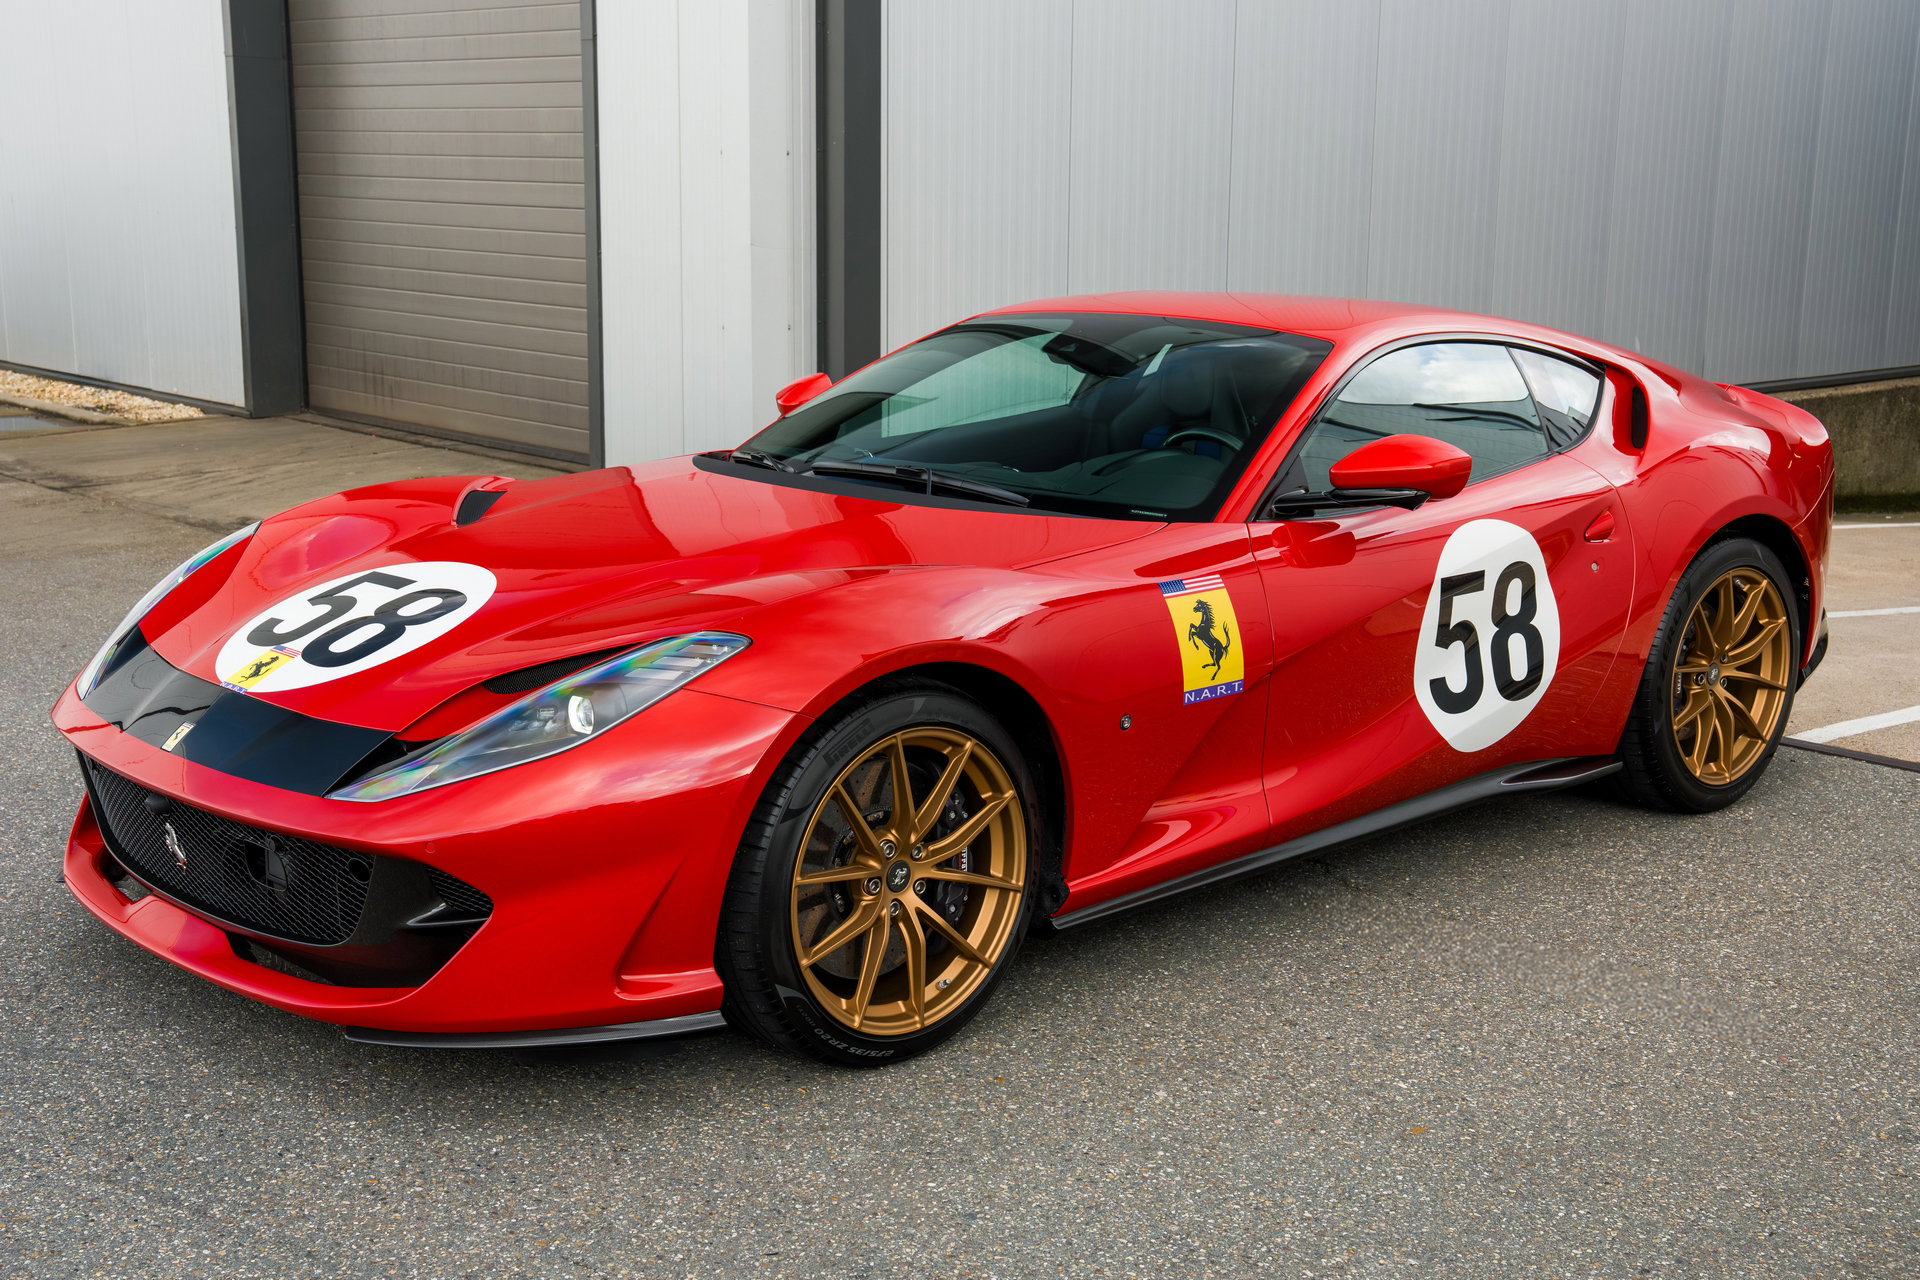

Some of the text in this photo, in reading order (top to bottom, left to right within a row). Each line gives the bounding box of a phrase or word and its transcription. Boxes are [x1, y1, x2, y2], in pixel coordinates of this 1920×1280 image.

[247, 571, 467, 667] 58
[1429, 561, 1544, 715] 58
[1184, 681, 1243, 703] N.A.R.T.
[814, 1028, 849, 1050] ZR20
